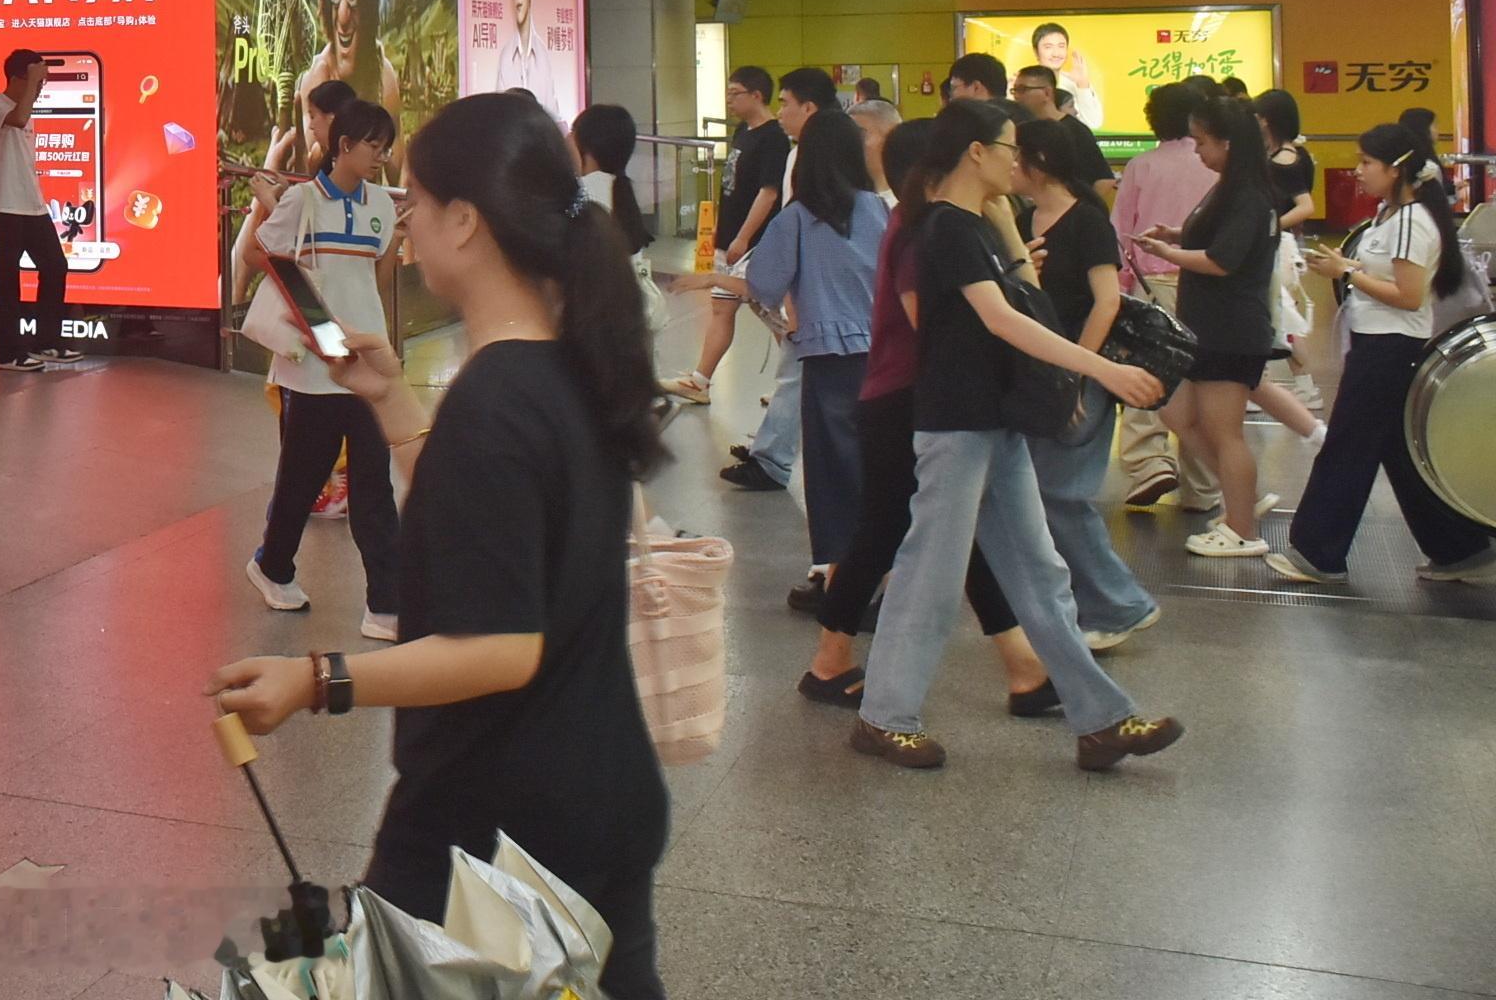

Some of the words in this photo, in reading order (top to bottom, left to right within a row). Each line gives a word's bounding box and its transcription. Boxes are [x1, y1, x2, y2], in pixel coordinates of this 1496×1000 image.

[11, 17, 71, 29] 进入天猫旗舰店
[233, 15, 250, 35] 斧头
[472, 22, 497, 49] AI导购
[234, 37, 270, 84] Pro
[1345, 60, 1432, 93] 无穷
[60, 319, 109, 340] EDIA
